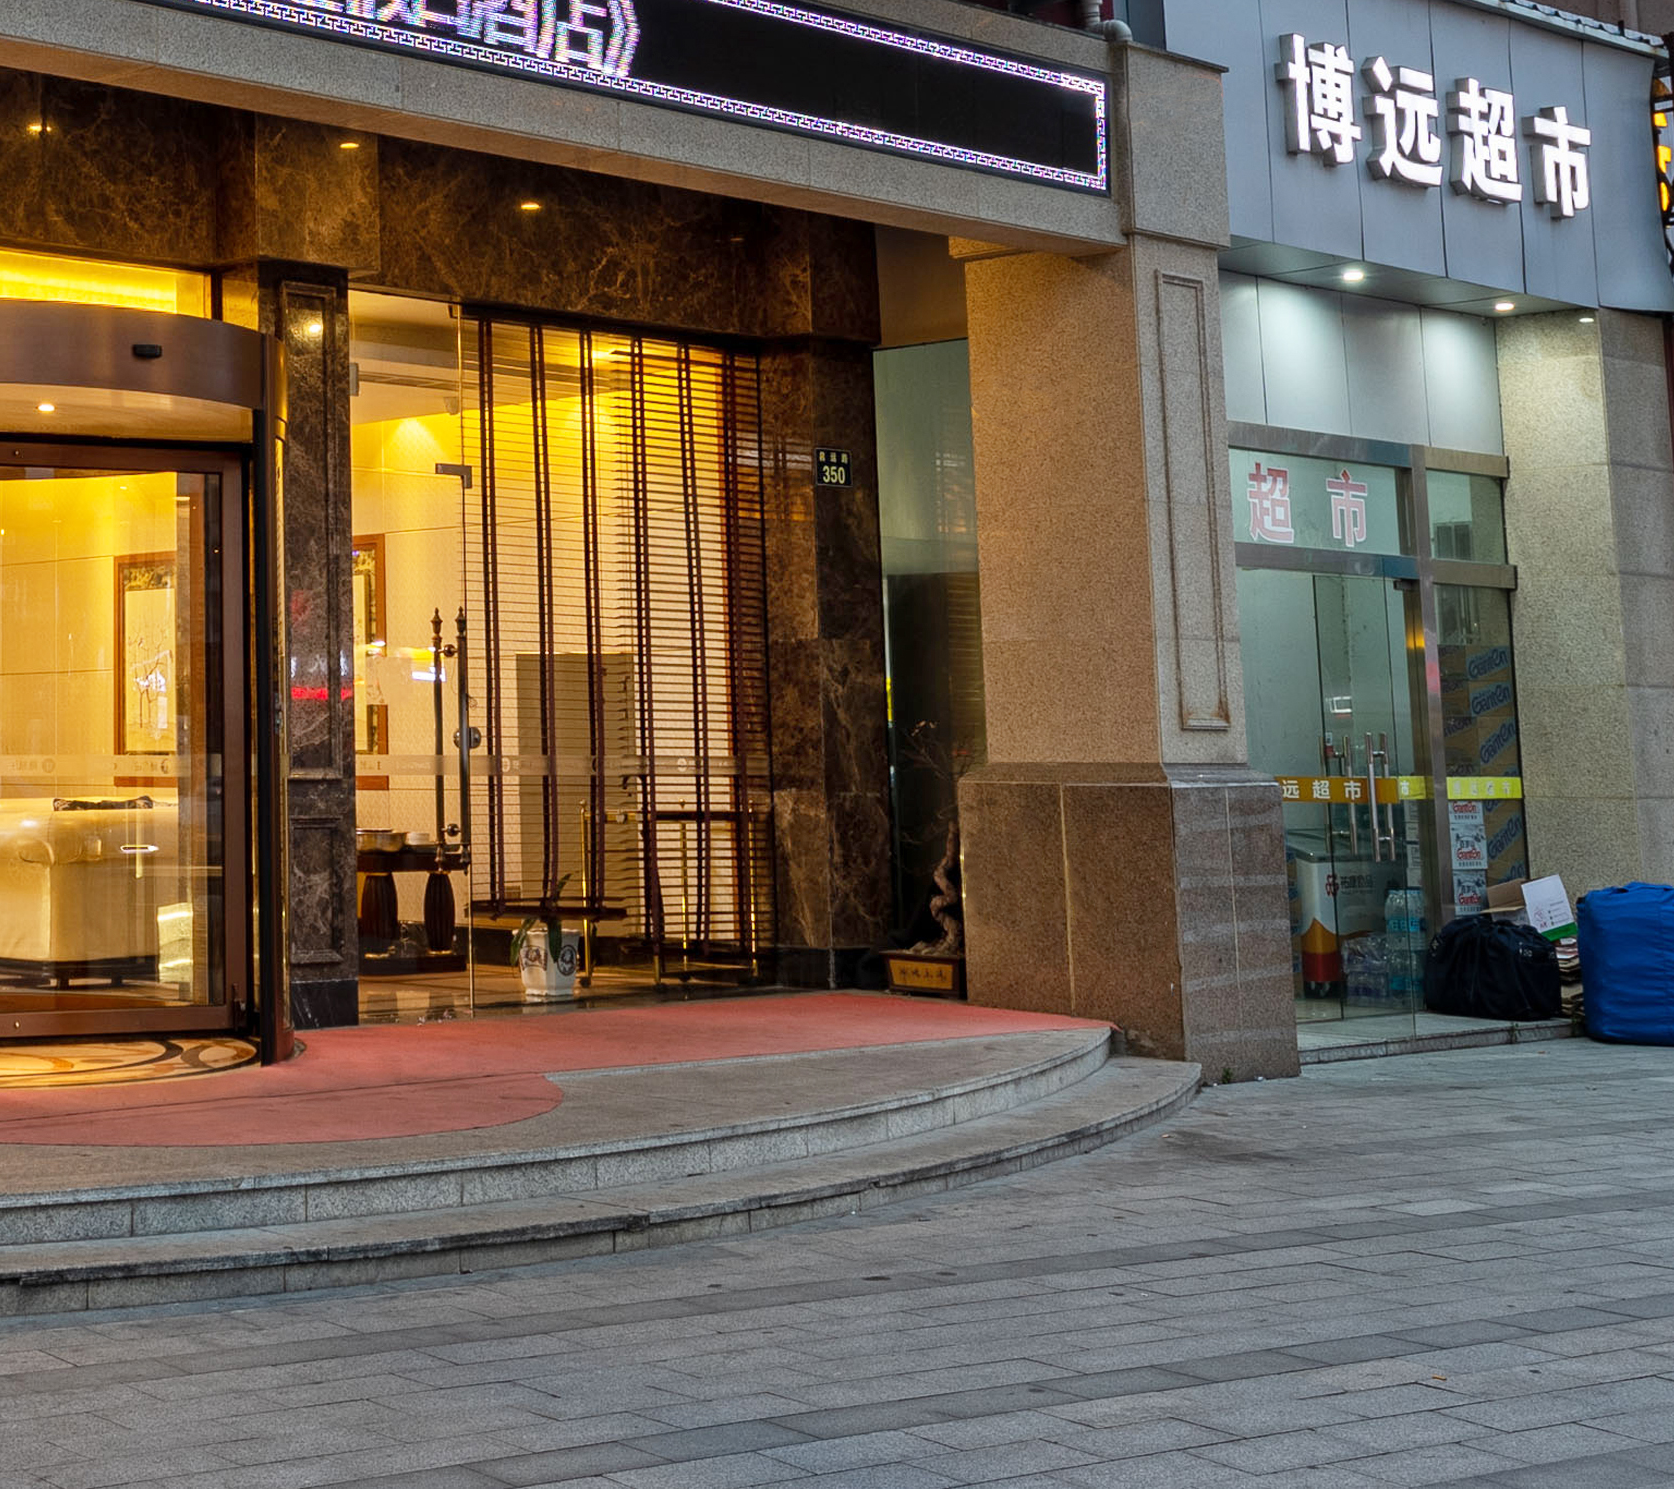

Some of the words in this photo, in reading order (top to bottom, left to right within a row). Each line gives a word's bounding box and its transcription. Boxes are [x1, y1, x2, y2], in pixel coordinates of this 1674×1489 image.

[1282, 33, 1591, 219] 博远超市
[822, 465, 846, 485] 350
[1247, 461, 1368, 548] 超市
